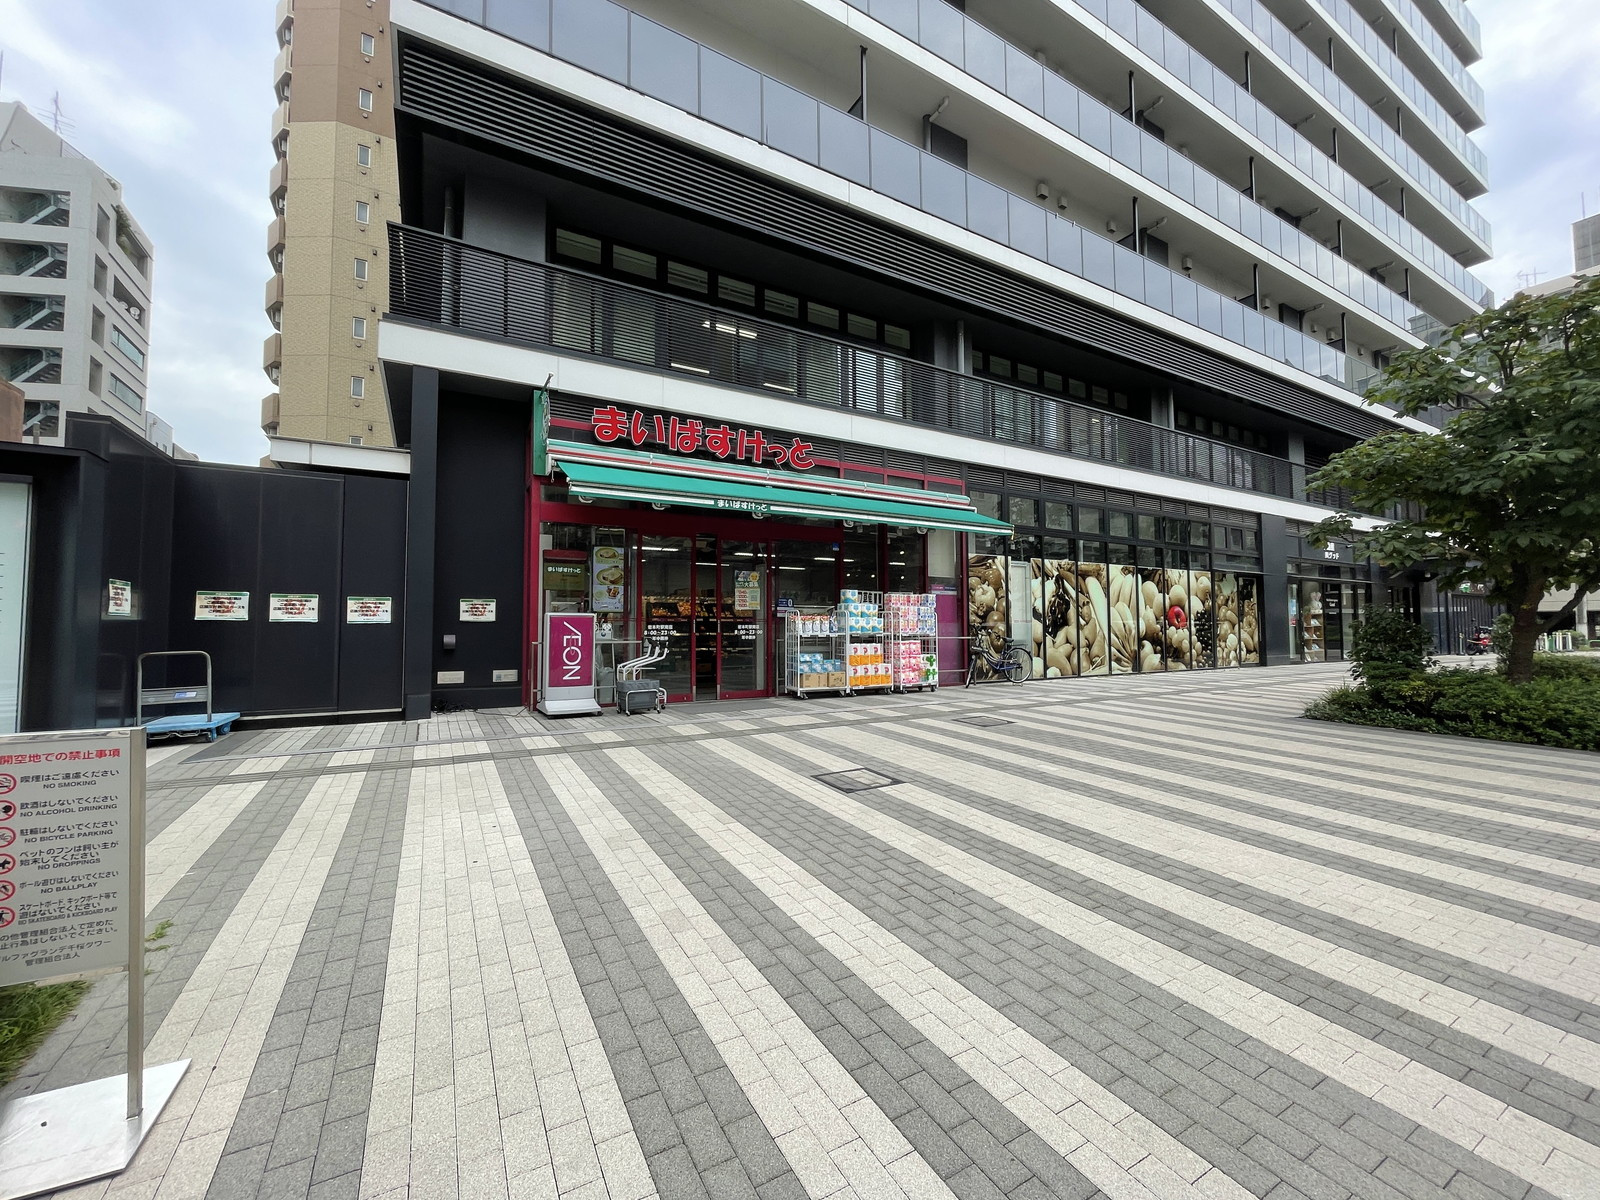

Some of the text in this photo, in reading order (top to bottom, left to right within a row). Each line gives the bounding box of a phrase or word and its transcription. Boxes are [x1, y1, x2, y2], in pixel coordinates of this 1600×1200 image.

[591, 405, 815, 470] まいばすけっと
[717, 499, 768, 511] まいばすけっと
[563, 621, 581, 680] AEON
[20, 769, 120, 784] 喫煙はご遠慮ください
[58, 780, 97, 788] SMOKING
[20, 795, 118, 810] 飲酒はしないでください
[35, 807, 76, 817] ALCOHOL
[78, 803, 118, 812] DRINKING
[20, 820, 118, 836] 駐輪はしないでください
[39, 833, 75, 842] BICYCLE
[77, 829, 113, 838] PARKING
[20, 841, 119, 857] ペットのフンは飼い主が
[19, 851, 99, 867] 始末してください
[53, 858, 101, 869] DROPPINGS
[19, 871, 119, 889] ボール遊びはしないでください
[55, 882, 98, 892] BALLPLAY
[28, 914, 66, 924] SKATEBOARD
[72, 908, 104, 918] KICKBOARD
[25, 952, 81, 966] 管理組合法人
